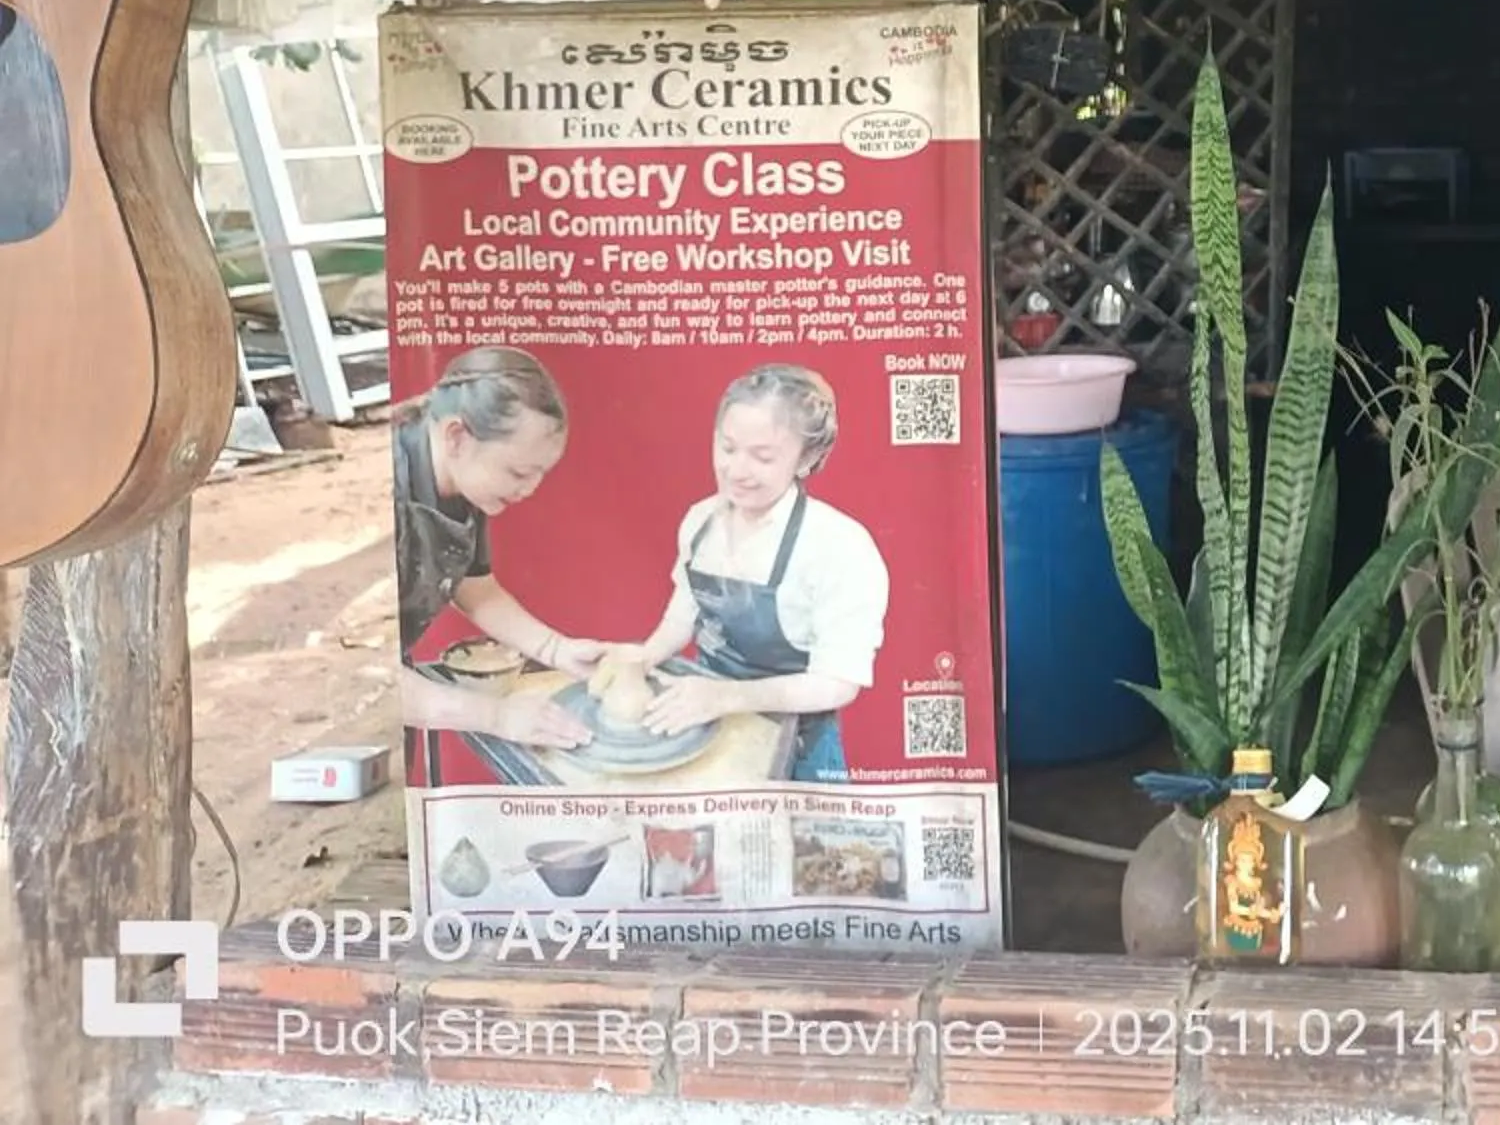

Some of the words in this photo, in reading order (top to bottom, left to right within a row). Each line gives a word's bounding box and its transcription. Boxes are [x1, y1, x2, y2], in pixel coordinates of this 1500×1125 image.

[460, 71, 634, 111] Khmer
[651, 65, 892, 110] Ceramics
[561, 117, 622, 139] Fine
[629, 116, 688, 138] Arts
[698, 114, 792, 137] Centre
[851, 131, 885, 141] YOUR
[859, 142, 889, 152] NEXT
[893, 141, 917, 151] DAY
[507, 155, 687, 209] Pottery
[703, 152, 846, 198] Class
[463, 210, 541, 236] Local
[548, 207, 721, 242] Community
[730, 205, 903, 237] Experience
[419, 245, 467, 271] Art
[474, 246, 574, 277] Gallery
[601, 245, 668, 272] Free
[675, 241, 832, 273] Workshop
[840, 239, 912, 265] Visit
[394, 280, 441, 295] You'll
[448, 280, 491, 294] make
[515, 280, 550, 296] pots
[556, 280, 588, 294] with
[594, 282, 604, 294] a
[611, 280, 704, 295] Cambodian
[710, 280, 768, 293] master
[774, 277, 838, 294] potter's
[845, 275, 926, 293] guidance.
[934, 273, 965, 287] One
[396, 298, 424, 315] pot
[429, 297, 445, 311] is
[451, 296, 487, 311] fired
[493, 296, 517, 310] for
[522, 296, 553, 311] free
[558, 297, 631, 315] overnight
[637, 296, 668, 311] and
[673, 296, 720, 313] ready
[726, 295, 750, 310] for
[756, 293, 818, 311] pick-up
[824, 293, 851, 307] the
[857, 292, 895, 306] next
[900, 290, 930, 307] day
[936, 291, 951, 304] at
[955, 289, 967, 304] 6
[397, 317, 428, 332] pm.
[434, 314, 459, 328] It's
[464, 316, 475, 328] a
[481, 315, 542, 331] unique,
[547, 315, 612, 329] creative,
[617, 314, 648, 328] and
[653, 313, 680, 327] fun
[686, 315, 721, 332] way
[726, 313, 744, 327] to
[748, 311, 792, 326] learn
[798, 310, 857, 328] pottery
[864, 309, 896, 323] and
[902, 306, 967, 322] connect
[397, 332, 432, 346] with
[436, 331, 463, 345] the
[466, 331, 505, 345] local
[510, 331, 599, 348] community.
[602, 331, 648, 349] Daily:
[700, 330, 744, 345] 10am
[757, 328, 794, 346] 2pm
[807, 327, 849, 345] 4pm.
[852, 325, 930, 341] Duration:
[933, 324, 945, 338] 2
[948, 323, 963, 337] h.
[885, 353, 925, 371] Book
[929, 353, 966, 370] NOW
[903, 679, 964, 692] Location
[501, 800, 556, 817] Online
[562, 800, 608, 819] Shop
[625, 800, 697, 818] Express
[704, 796, 778, 815] Delivery
[784, 796, 799, 811] in
[805, 797, 847, 813] Siem
[851, 800, 896, 817] Reap
[751, 917, 835, 941] meets
[845, 915, 901, 940] Fine
[908, 921, 961, 944] Arts
